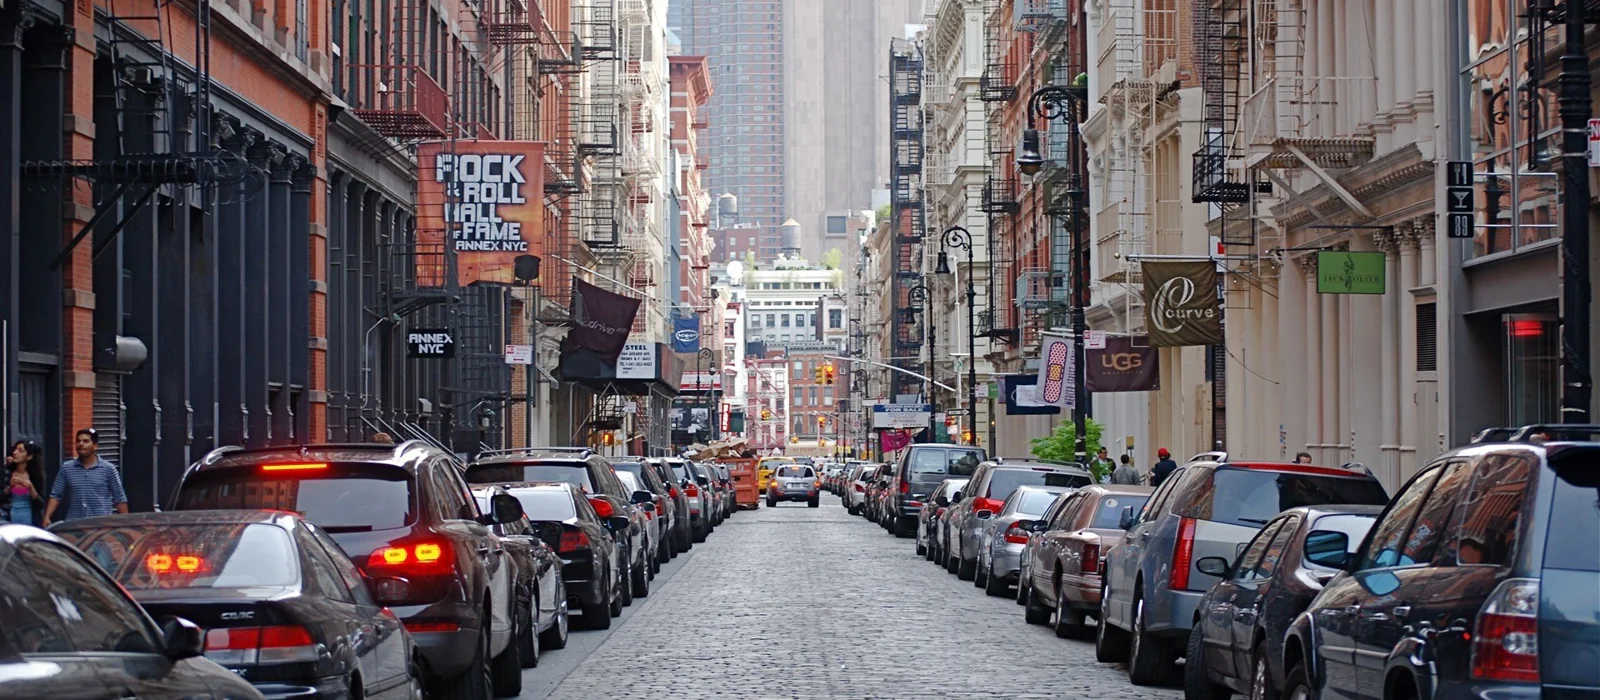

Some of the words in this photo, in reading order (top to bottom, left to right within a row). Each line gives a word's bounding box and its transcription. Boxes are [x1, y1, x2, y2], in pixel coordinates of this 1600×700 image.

[1591, 122, 1600, 138] N
[436, 154, 526, 183] ROCK
[463, 182, 526, 204] ROLL
[444, 203, 502, 223] HALL
[462, 222, 521, 240] FAME
[1455, 215, 1468, 237] 89
[455, 240, 500, 251] ANNEX
[502, 241, 528, 251] NYC
[1324, 275, 1345, 283] JACK
[1352, 275, 1380, 284] OLIVE
[588, 320, 615, 335] drive
[408, 333, 453, 344] ANNEX
[418, 343, 444, 354] NYC
[1101, 352, 1142, 371] UGG
